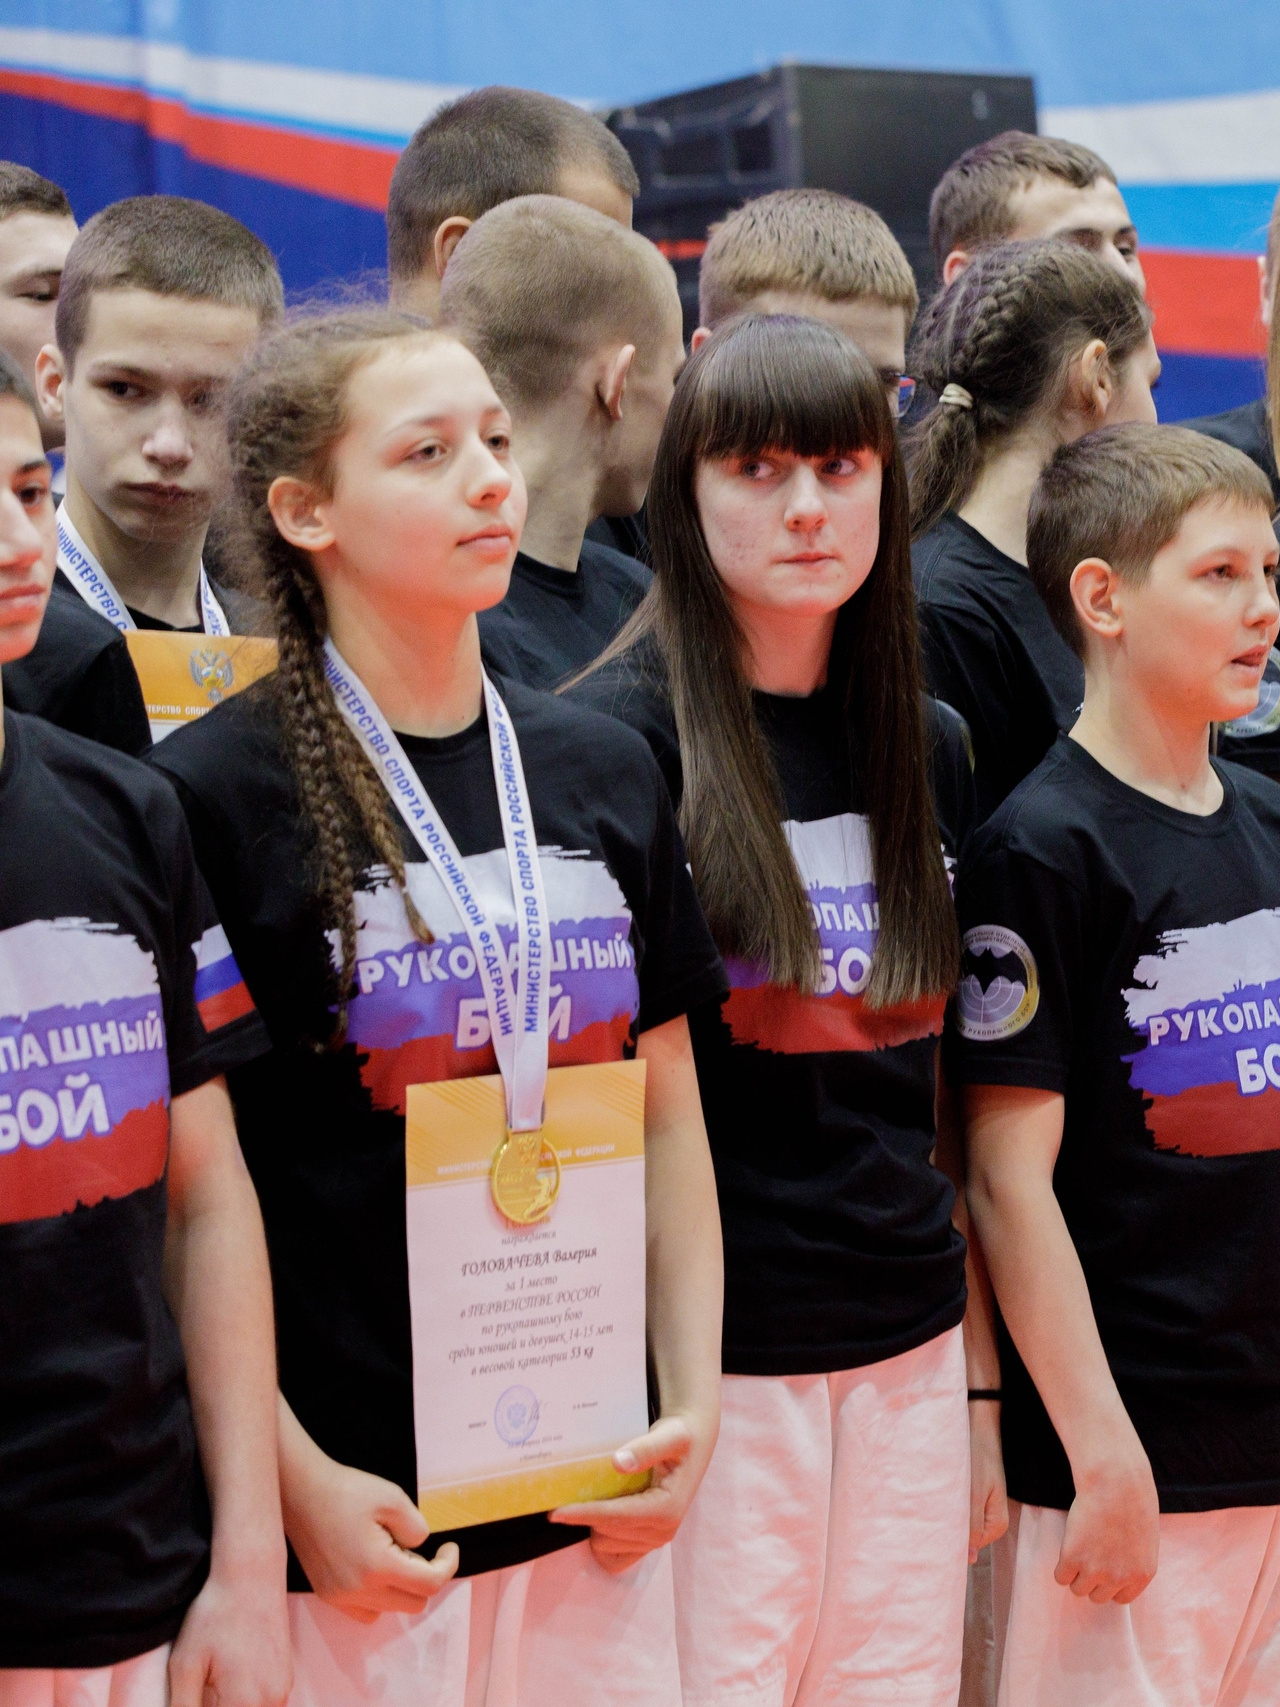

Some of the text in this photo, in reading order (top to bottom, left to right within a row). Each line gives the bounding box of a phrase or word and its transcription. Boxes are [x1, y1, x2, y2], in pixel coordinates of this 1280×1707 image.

[495, 722, 525, 824] РОССИЙСКОЙ
[324, 655, 513, 1036] НИСТЕРСТВО СПОРТА РОССИЙСКОЙ ФЕДЕРАЦИИ
[515, 830, 535, 891] СПОРТА
[358, 932, 632, 994] РУКОАШНЫЙ
[523, 897, 542, 1033] МИНИСТЕРСТВО
[456, 983, 571, 1048] БЙ
[461, 1247, 597, 1276] ГОЛОВАЧЕВА Валерия
[505, 1282, 516, 1291] за
[527, 1275, 558, 1288] место
[467, 1294, 554, 1318] ПЕРВЕНСТВЕ
[556, 1284, 603, 1303] РОССИИ
[481, 1307, 583, 1337] по рукопашному бою
[448, 1344, 475, 1363] среди
[478, 1337, 517, 1353] юношей
[528, 1331, 568, 1347] девушек
[567, 1325, 594, 1344] 14-15
[596, 1323, 613, 1336] лет
[479, 1357, 515, 1374] весовой
[517, 1350, 568, 1371] категории
[570, 1346, 582, 1359] 53
[584, 1346, 595, 1360] кг
